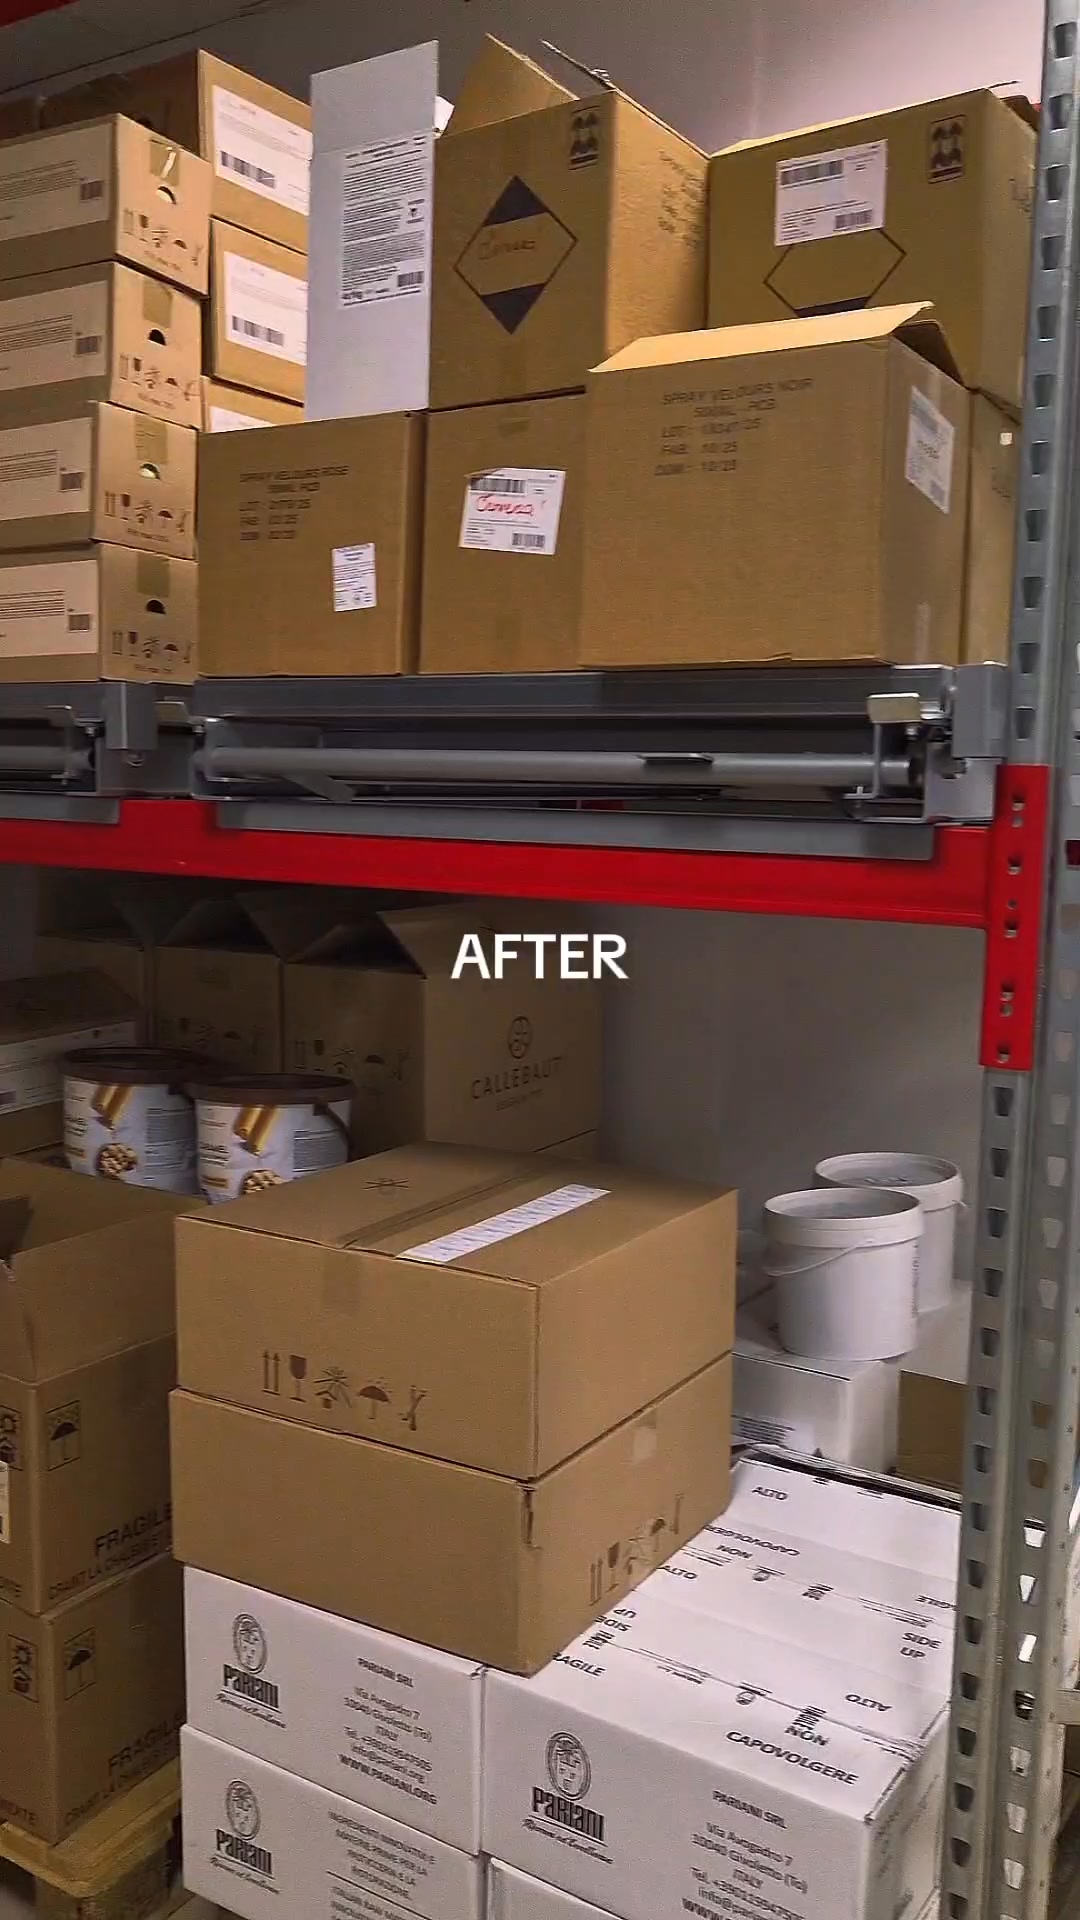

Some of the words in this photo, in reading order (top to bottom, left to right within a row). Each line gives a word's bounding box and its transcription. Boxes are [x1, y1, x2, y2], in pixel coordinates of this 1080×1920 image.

[471, 1056, 563, 1100] CALLEBAUT
[752, 1486, 789, 1501] ALTO
[716, 1544, 754, 1559] NON
[901, 1632, 942, 1650] SIDE
[899, 1646, 926, 1659] UP
[845, 1693, 893, 1712] ALTO
[784, 1724, 832, 1747] NON
[726, 1731, 860, 1785] CAPOVOLGERE
[712, 1790, 763, 1819] PARIANI
[763, 1811, 788, 1829] SRL
[705, 1822, 726, 1839] Via
[726, 1831, 783, 1863] Avogadro
[783, 1854, 794, 1866] 7
[732, 1868, 764, 1889] ITALY
